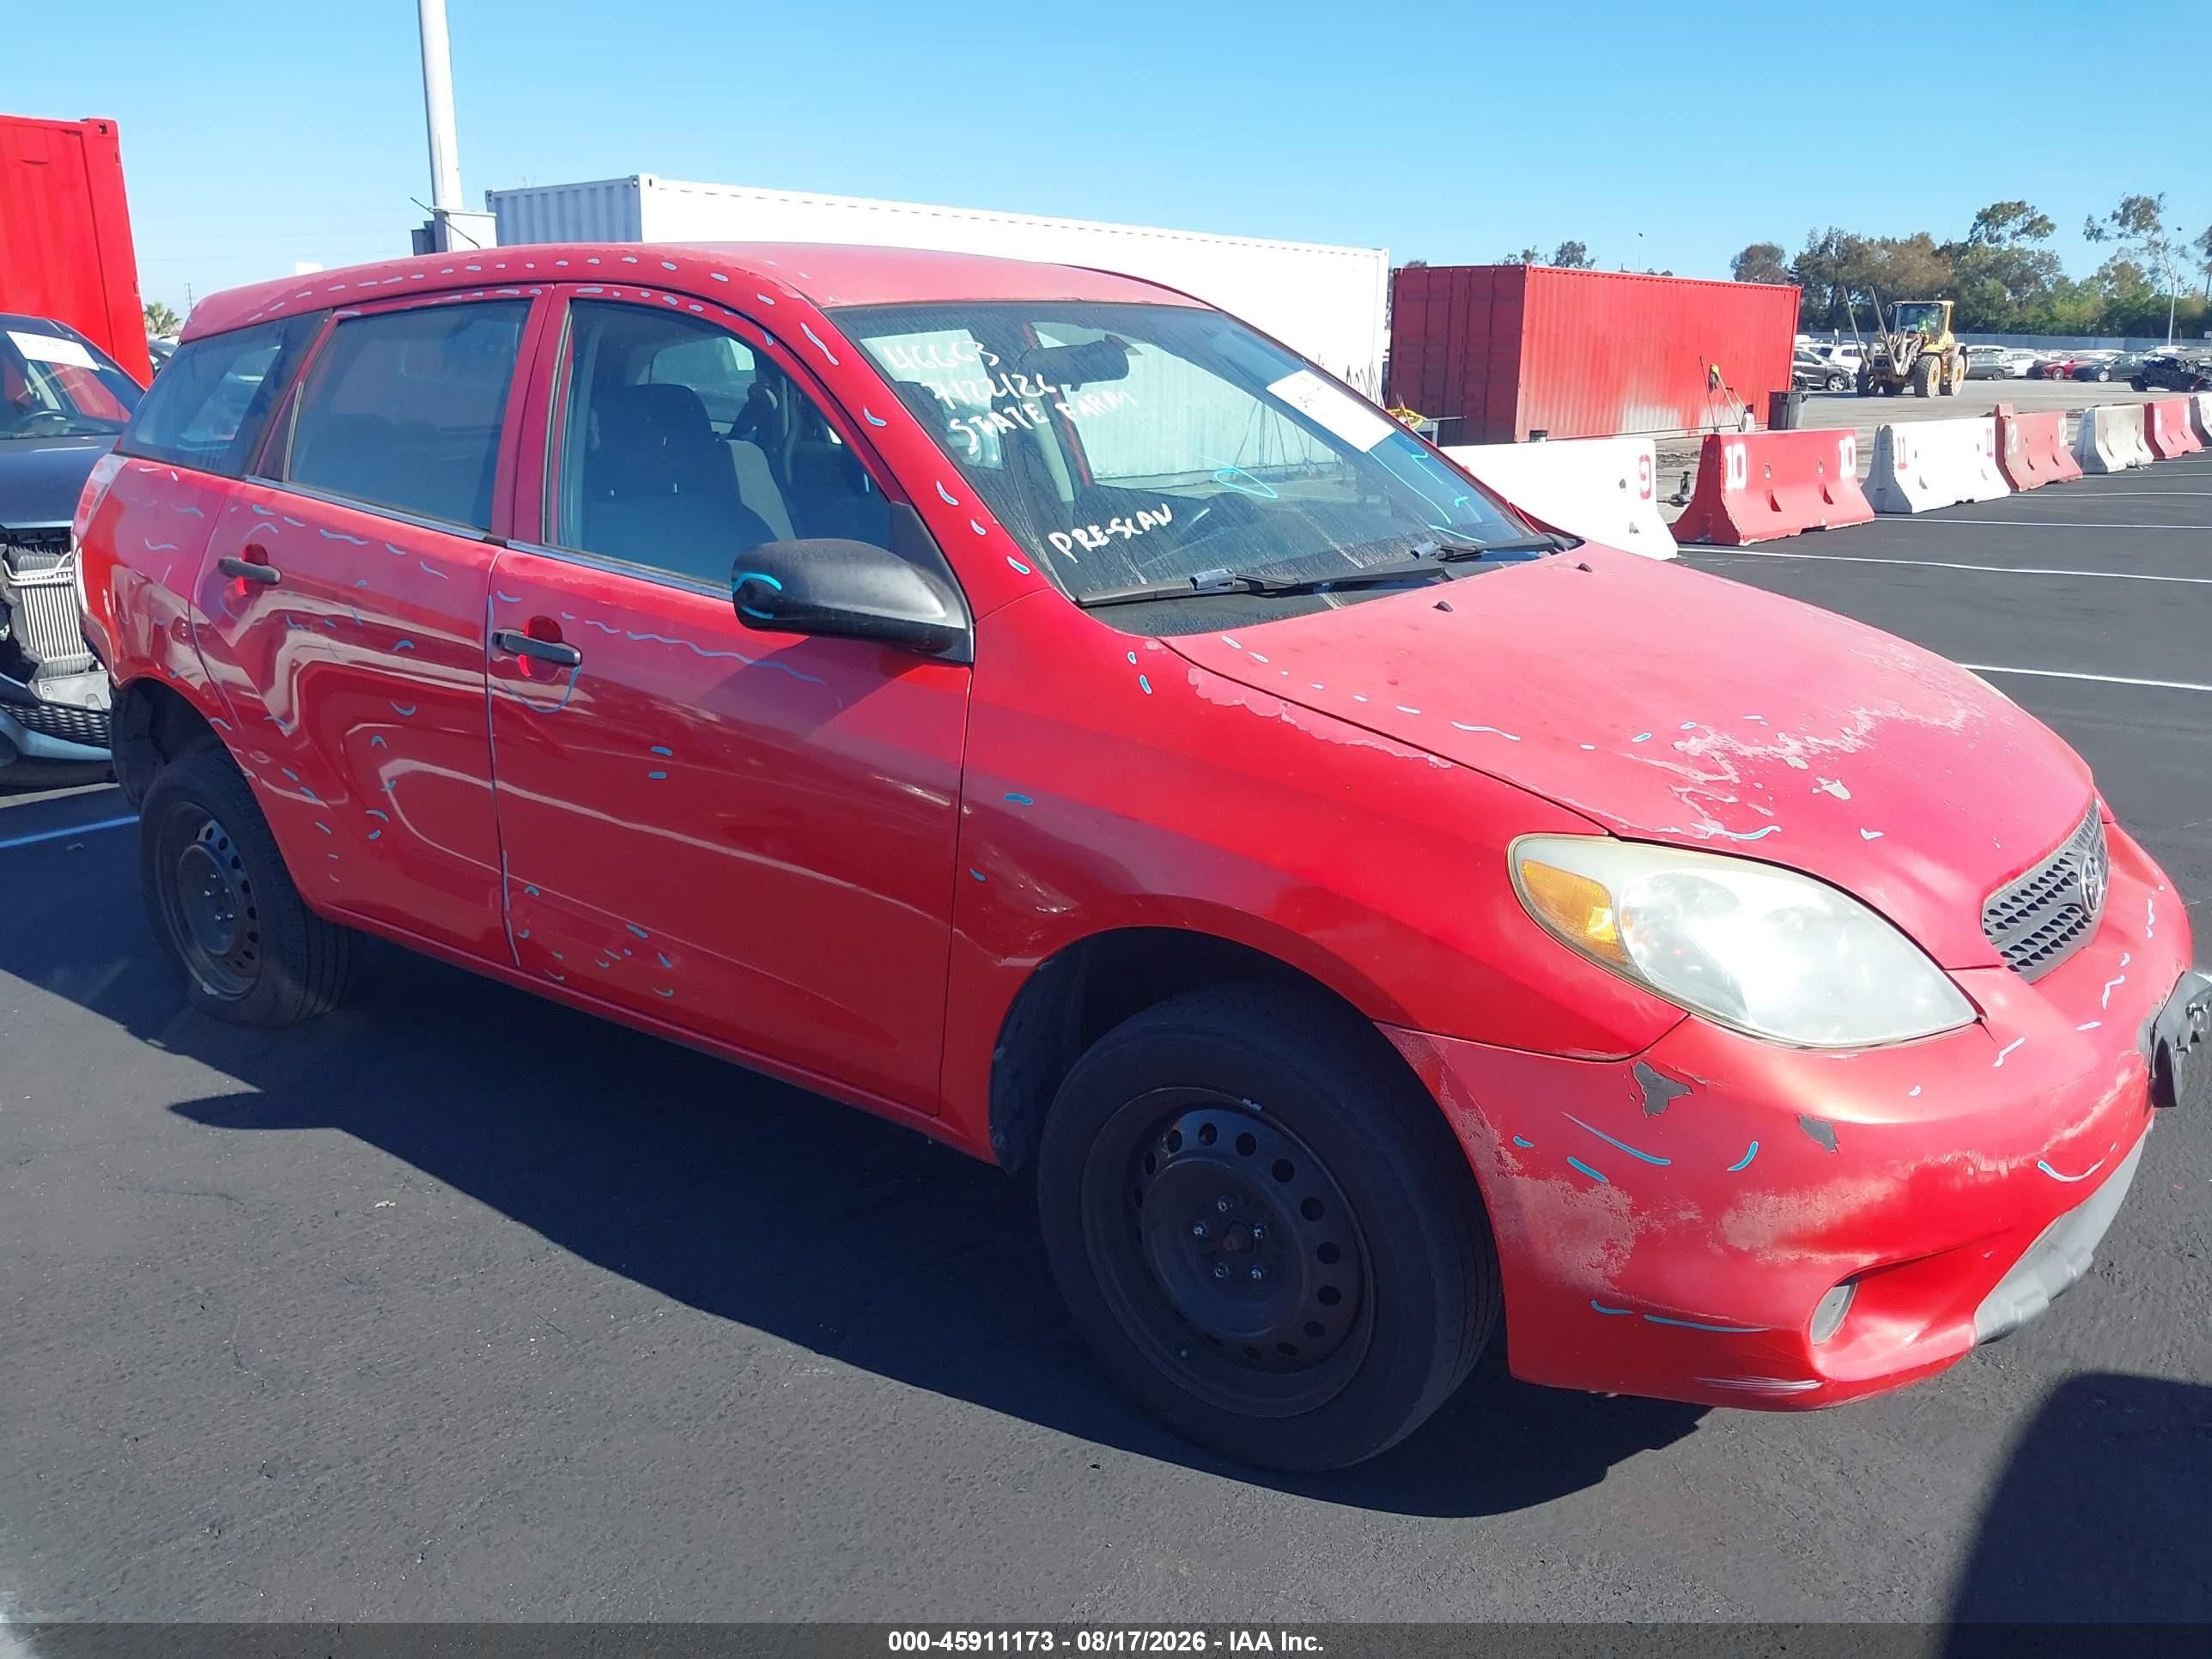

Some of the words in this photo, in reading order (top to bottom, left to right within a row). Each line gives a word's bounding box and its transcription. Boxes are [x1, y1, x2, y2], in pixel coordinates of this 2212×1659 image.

[950, 403, 1050, 454] STATE
[1055, 391, 1139, 422] FARM
[1638, 454, 1652, 500] 9
[1725, 443, 1747, 489] 10
[1838, 436, 1856, 480] 10
[1048, 503, 1173, 563] PRE-SCAN
